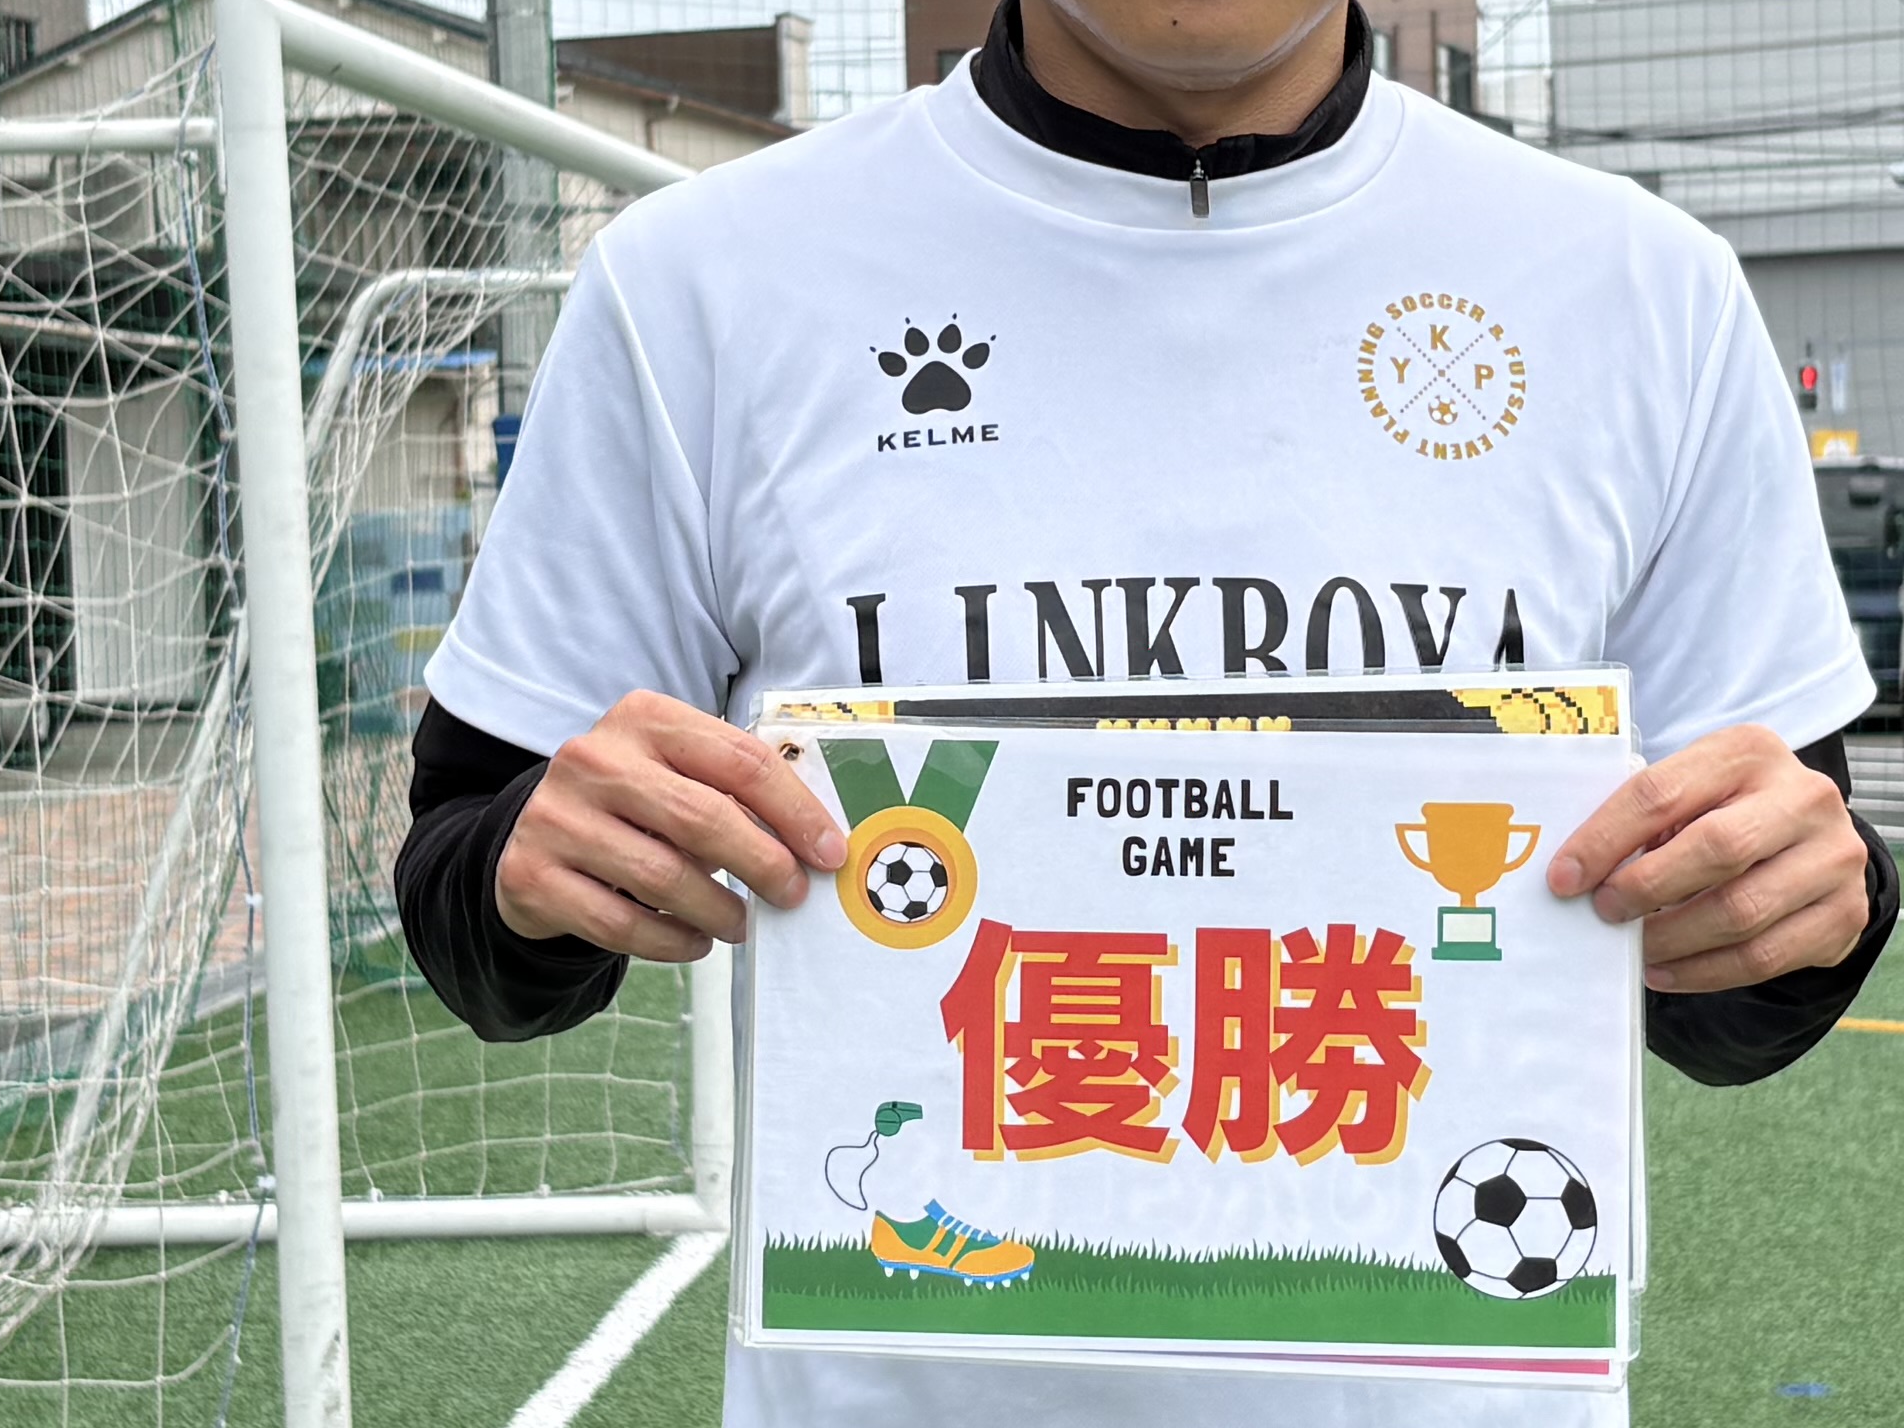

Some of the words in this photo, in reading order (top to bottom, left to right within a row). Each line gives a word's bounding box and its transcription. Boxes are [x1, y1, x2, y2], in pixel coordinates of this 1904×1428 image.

[1385, 292, 1486, 323] SOCCER
[1357, 322, 1410, 444] PLANNING
[1492, 345, 1526, 437] FUTSAL
[877, 423, 999, 452] KELME
[1415, 433, 1494, 460] EVENT
[1067, 777, 1293, 820] FOOTBALL
[1122, 836, 1235, 877] GAME
[940, 918, 1430, 1164] 優勝
